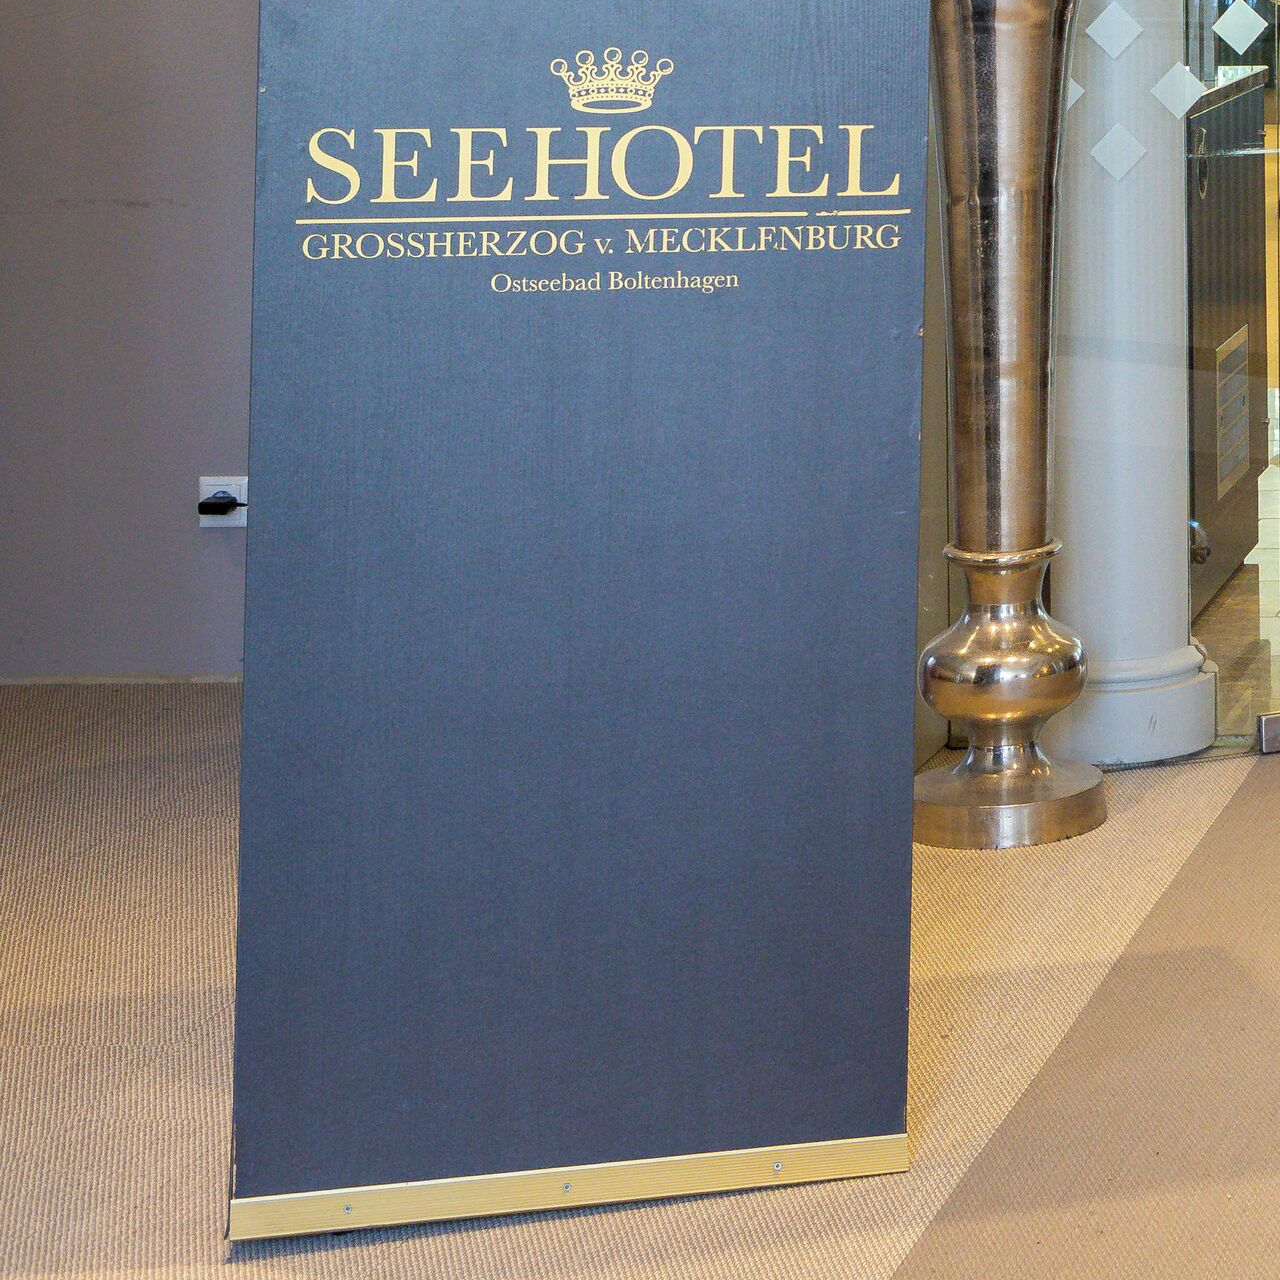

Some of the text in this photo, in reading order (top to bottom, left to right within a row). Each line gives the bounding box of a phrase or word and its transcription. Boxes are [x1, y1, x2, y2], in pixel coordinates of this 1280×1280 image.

[305, 124, 901, 205] SEEHOTEL
[301, 224, 903, 261] GROSSHERZOG v. MECKLENBURG
[490, 270, 740, 294] Ostseebad Boltenhagen
